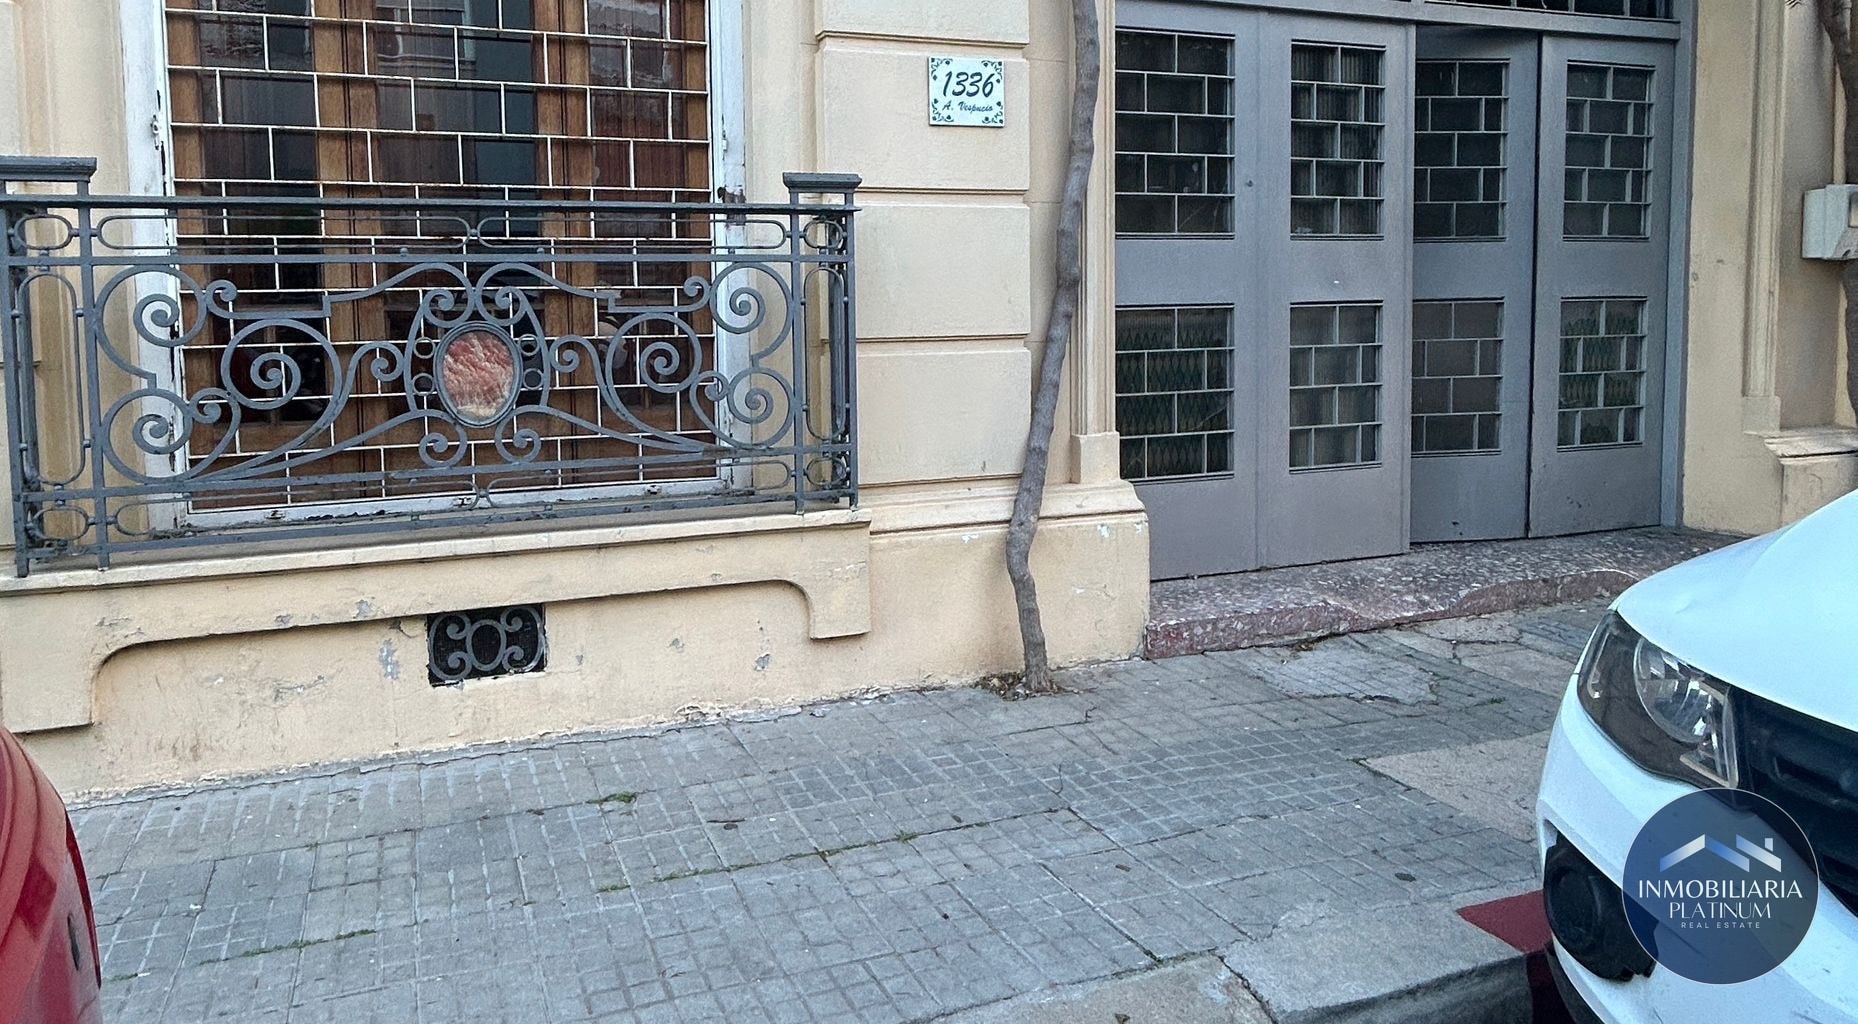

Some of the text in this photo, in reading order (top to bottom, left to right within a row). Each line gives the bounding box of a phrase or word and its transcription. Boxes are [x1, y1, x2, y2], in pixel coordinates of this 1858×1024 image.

[943, 71, 995, 98] 1336
[942, 100, 994, 114] A. Vespucio
